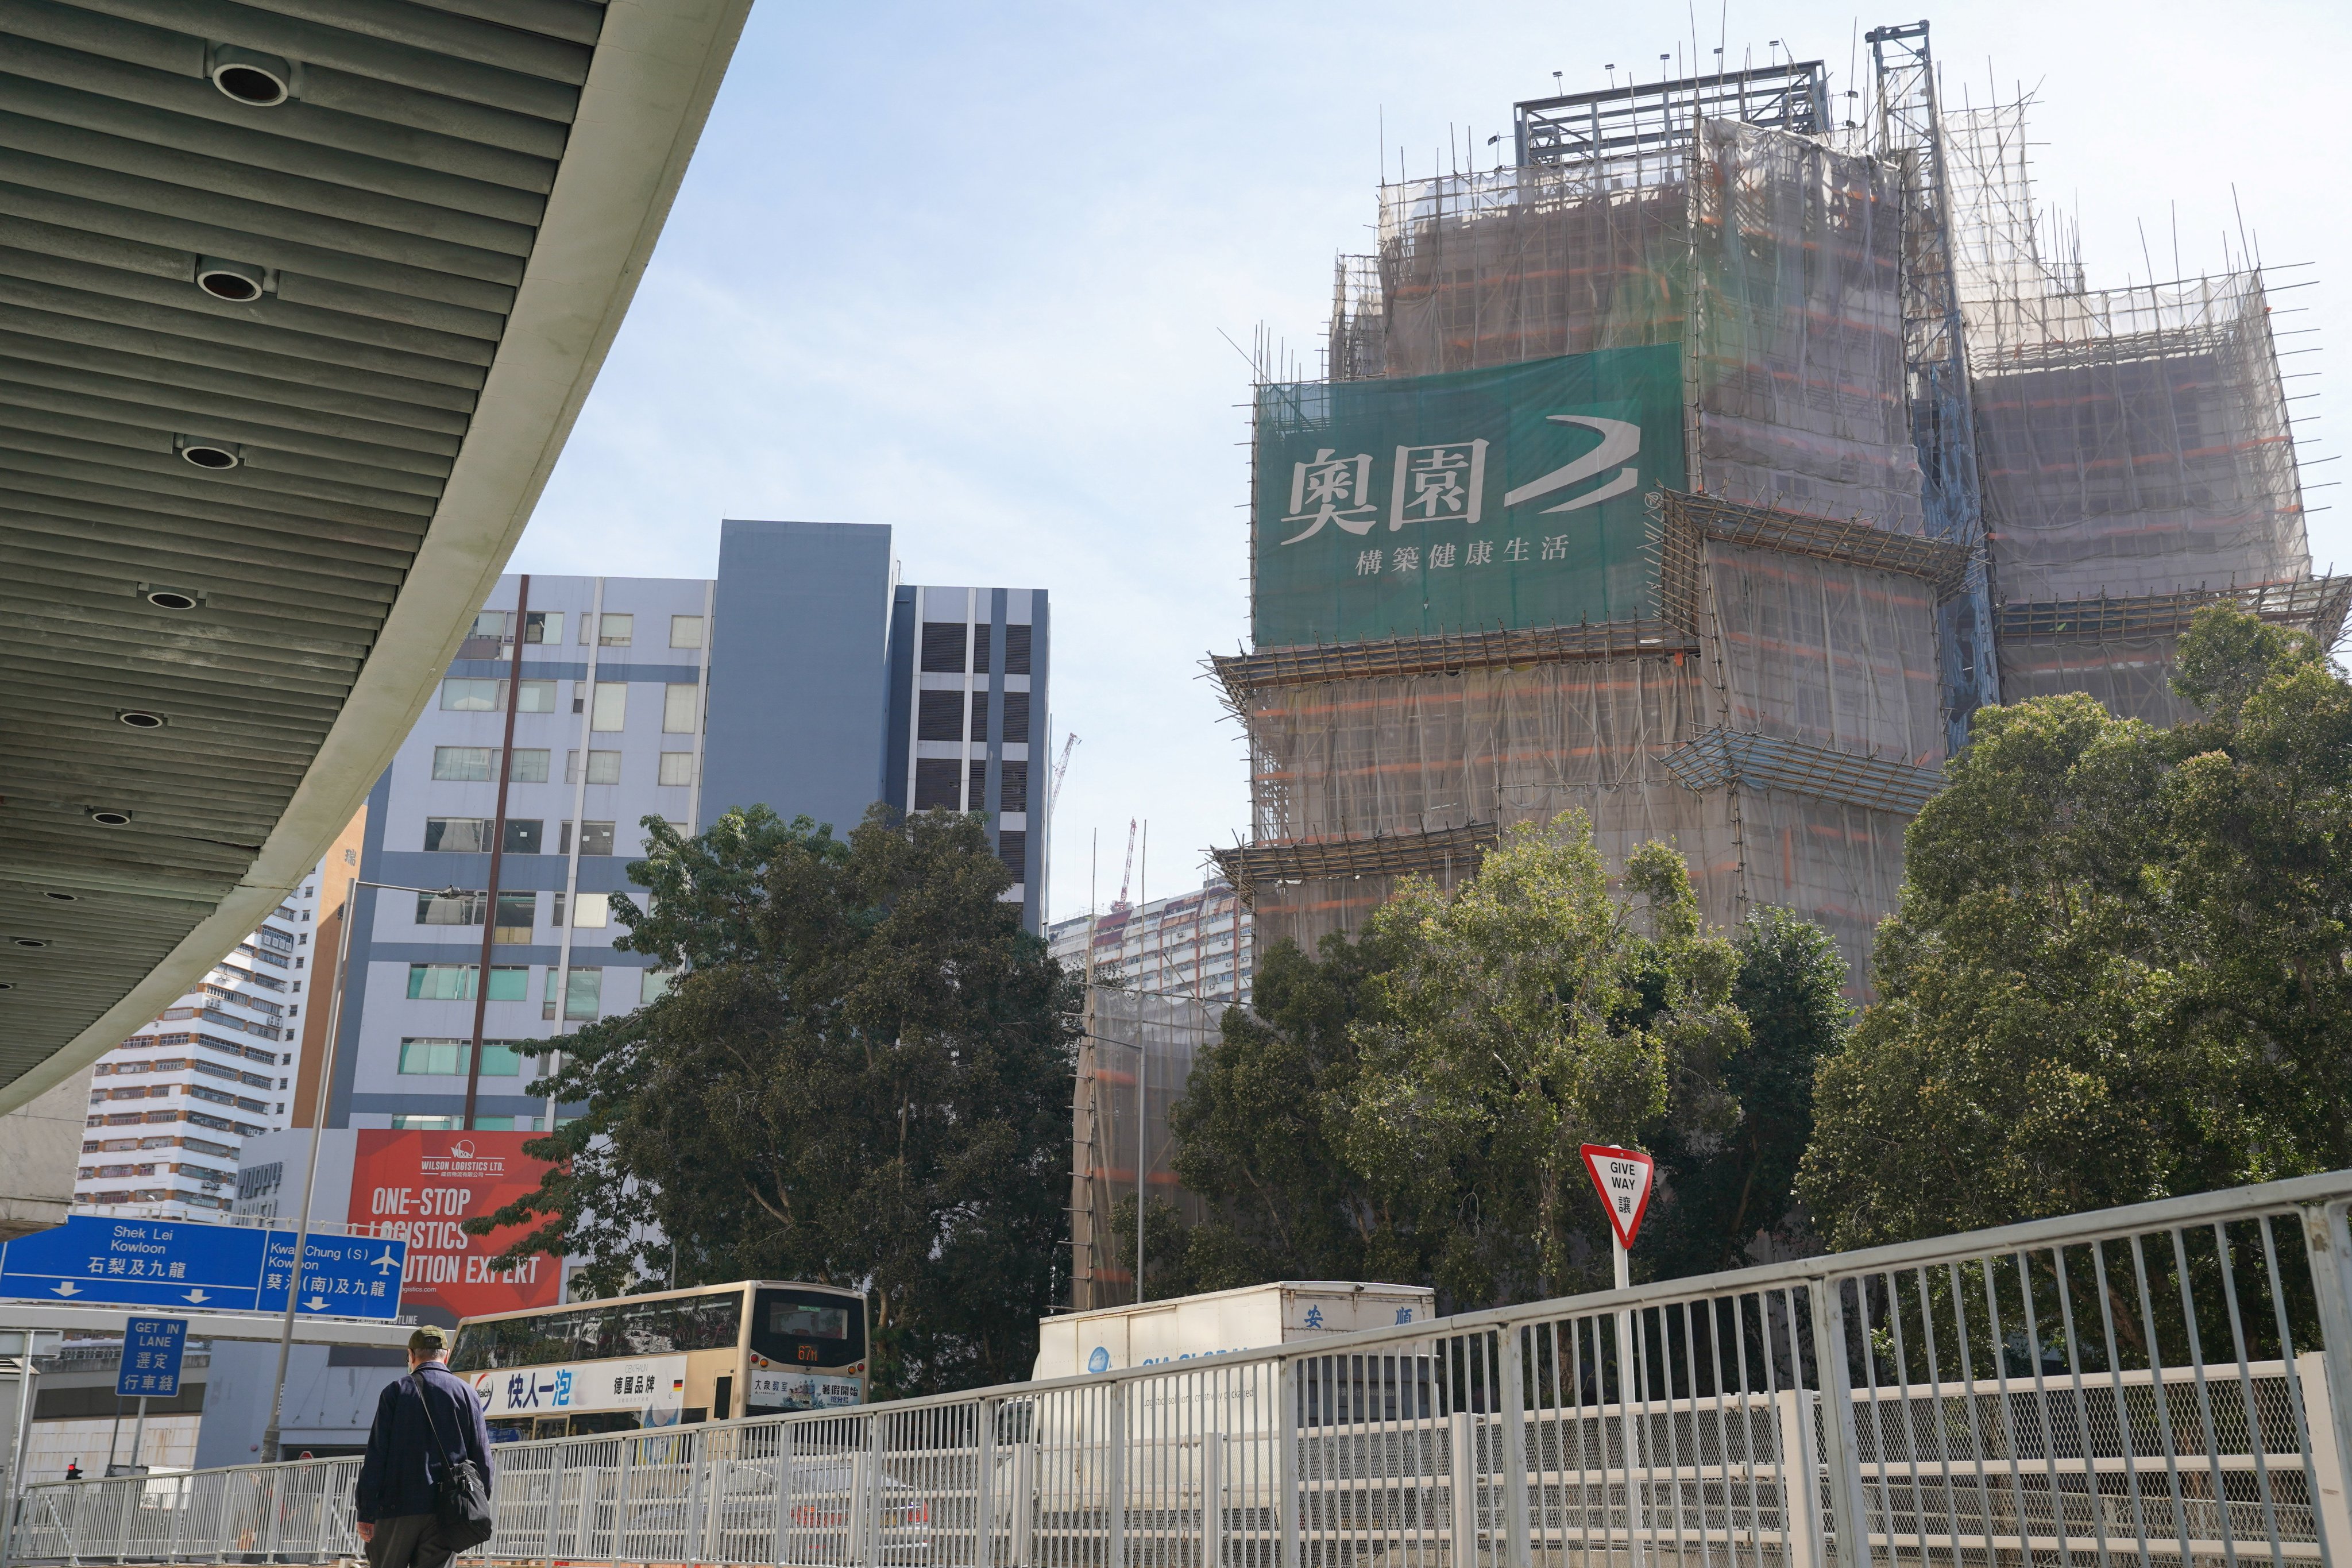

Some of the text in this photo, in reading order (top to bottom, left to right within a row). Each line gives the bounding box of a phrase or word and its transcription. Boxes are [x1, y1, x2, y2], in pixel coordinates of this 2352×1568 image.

[1280, 438, 1490, 546] 奧園
[1355, 534, 1569, 576] 構築健康生活
[422, 1161, 504, 1171] WILSON LOGISTICS LTD.
[1611, 1161, 1635, 1176] GIVE
[1612, 1176, 1635, 1190] WAY
[372, 1187, 470, 1215] ONE-STOP
[1619, 1196, 1631, 1214] 讓
[113, 1226, 173, 1241] Shek Lei
[110, 1240, 165, 1254] Kowloon
[271, 1242, 368, 1261] Kwa Chung (S)
[87, 1257, 186, 1279] 石梨及九龍
[135, 1322, 179, 1334] GET IN
[139, 1335, 171, 1347] LANE
[136, 1352, 168, 1369] 選定
[508, 1369, 572, 1409] 快人一泡
[614, 1375, 655, 1395] 德國品牌
[822, 1384, 858, 1397] 暑假開始
